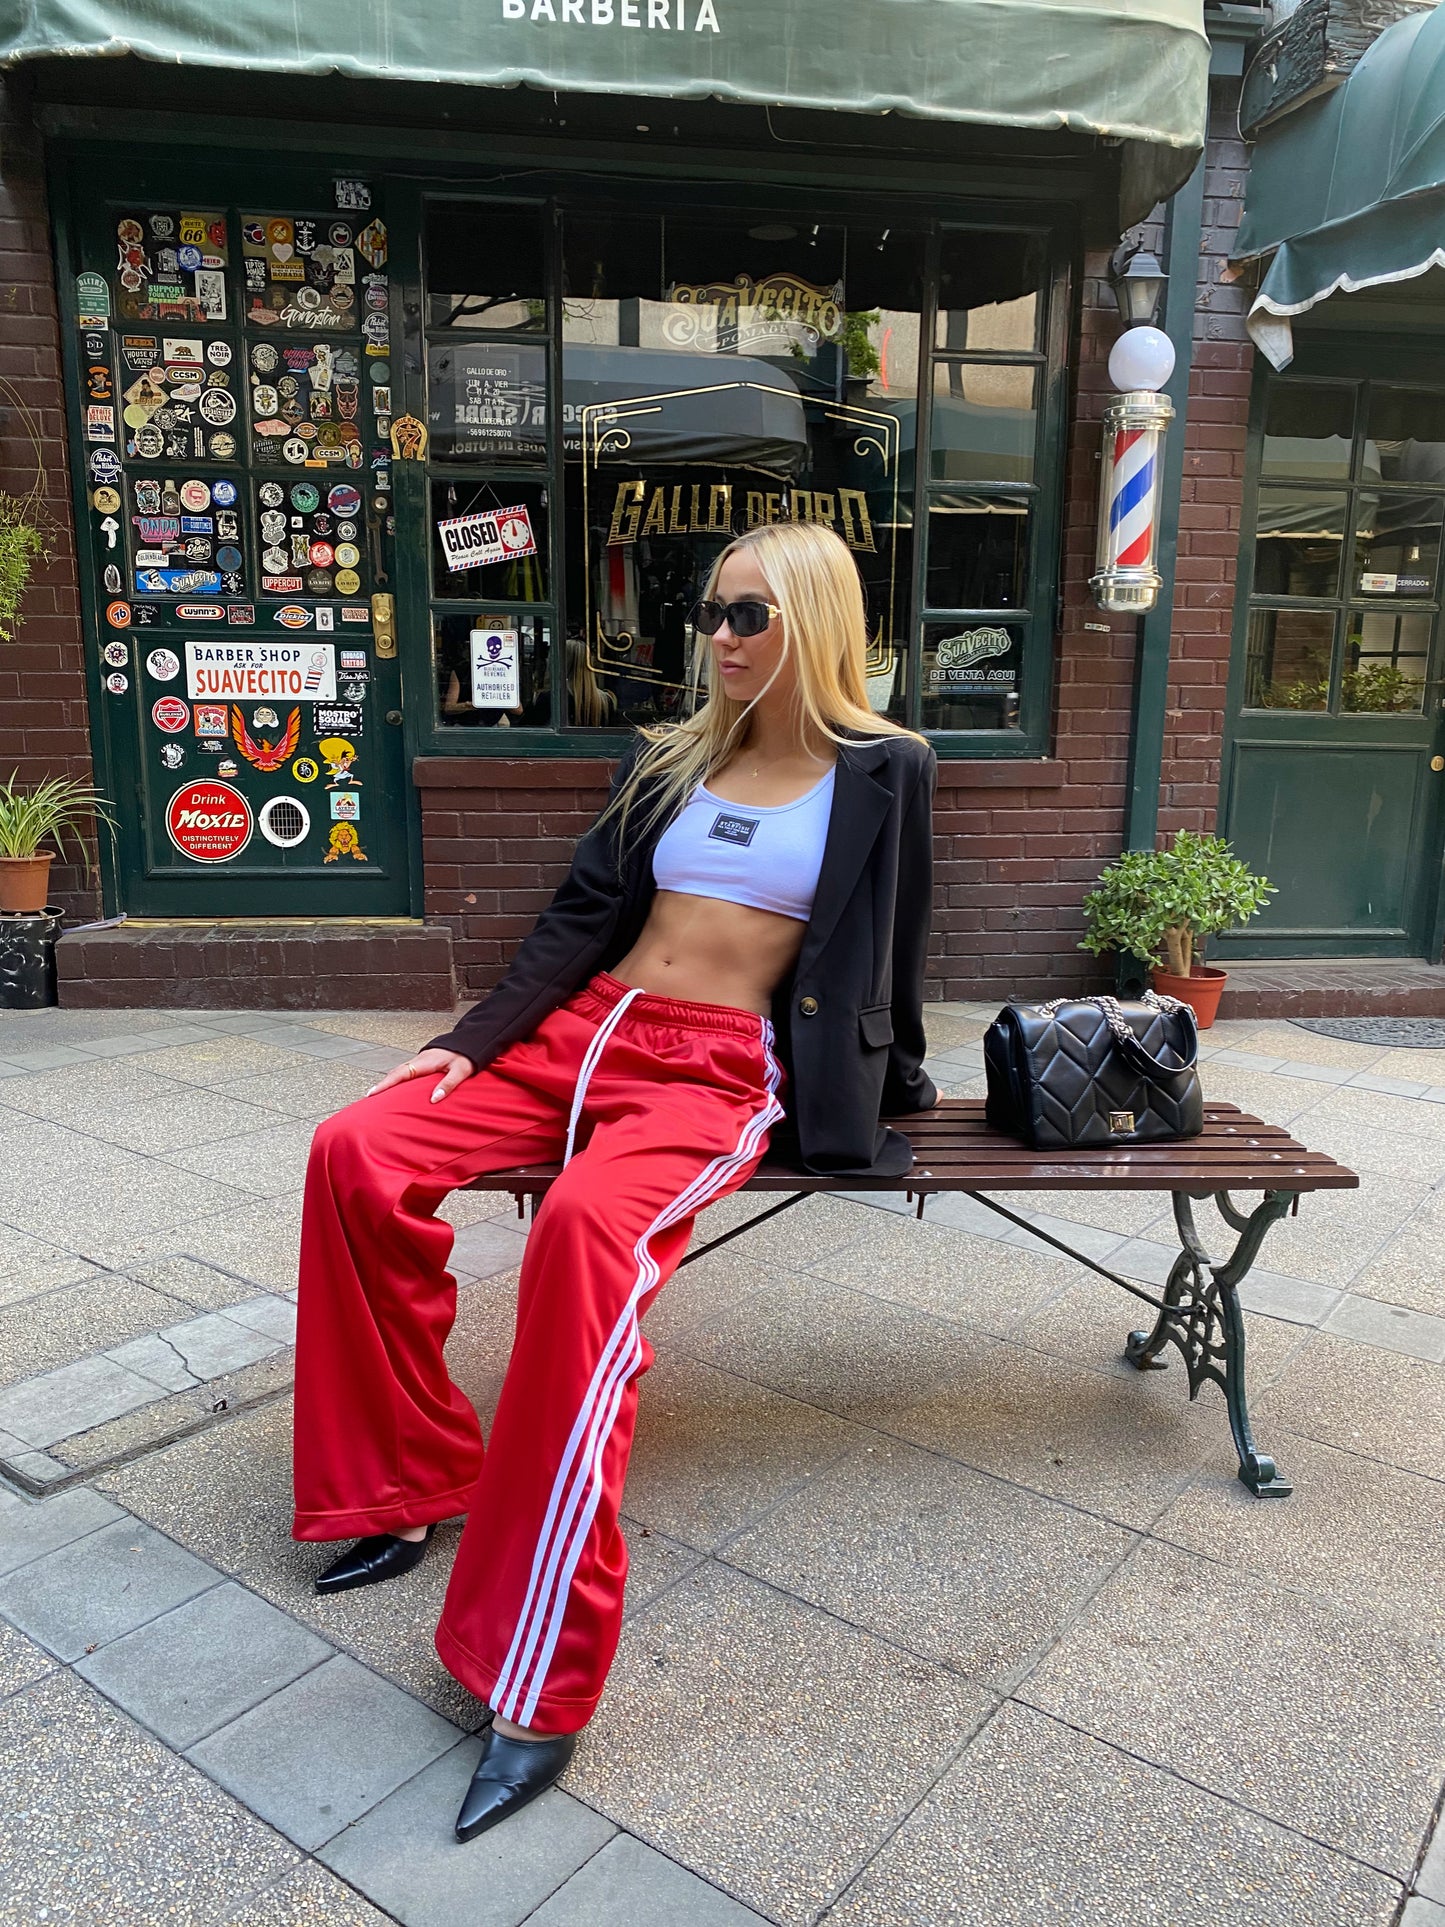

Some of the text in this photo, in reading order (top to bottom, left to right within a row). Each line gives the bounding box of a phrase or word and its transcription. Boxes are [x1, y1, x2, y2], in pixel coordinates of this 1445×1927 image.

[502, 0, 721, 33] BARBERIA
[183, 229, 203, 243] 66
[148, 285, 185, 293] SUPPORT
[662, 276, 842, 346] SUAVECITO
[721, 324, 790, 347] POMADE
[127, 351, 158, 359] HOUSE OF
[133, 358, 153, 366] VANS
[173, 371, 197, 379] CCSM
[466, 367, 507, 377] GALLO DE ORO
[484, 380, 490, 388] A
[494, 380, 509, 388] VIER
[95, 453, 113, 463] Pabst
[606, 479, 878, 553] GALLO DE ORO
[445, 520, 499, 553] CLOSED
[186, 543, 210, 556] Eddy's
[451, 546, 501, 561] Please Call Again
[264, 578, 300, 587] UPPERCUT
[113, 608, 127, 623] 76
[939, 628, 1009, 665] SUAVECITO
[195, 649, 301, 662] BARBER SHOP
[930, 670, 1016, 680] DE VENTA AQUI
[195, 669, 303, 694] SUAVECITO
[476, 683, 515, 692] AUTHORISED
[481, 691, 511, 700] RETAILER
[318, 710, 357, 719] MOSTRO
[318, 716, 351, 724] SQUAD
[192, 794, 226, 805] Drink
[175, 809, 245, 831] MOXIE
[182, 835, 239, 843] DISTINCTIVELY
[189, 842, 233, 850] DIFFERENT
